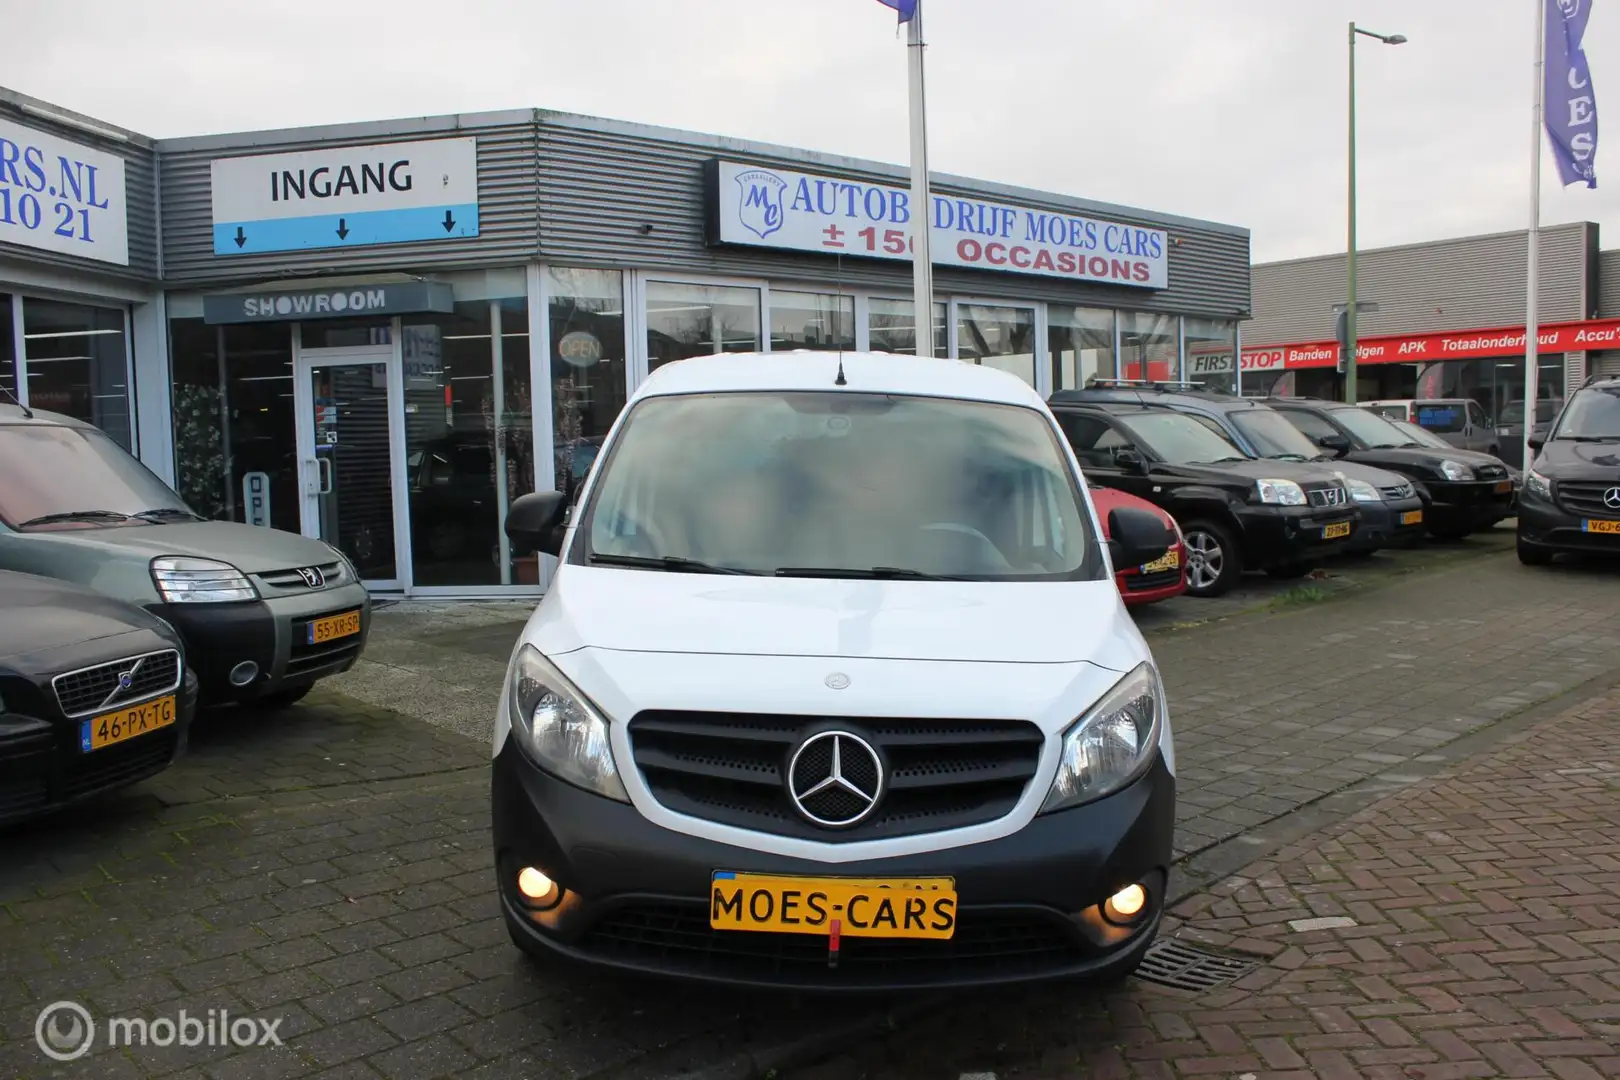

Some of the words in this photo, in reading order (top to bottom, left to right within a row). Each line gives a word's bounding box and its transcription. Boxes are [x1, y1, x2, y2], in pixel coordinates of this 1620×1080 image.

[271, 160, 413, 202] INGANG
[54, 202, 95, 243] 21
[790, 176, 1017, 238] AUTOBDRIJF
[1024, 211, 1097, 250] MOES
[1103, 225, 1162, 260] CARS
[858, 226, 914, 254] 15
[956, 238, 1151, 282] OCCASIONS
[243, 289, 386, 317] SHOWROOM
[559, 339, 600, 358] OPEN
[1240, 351, 1282, 369] STOP
[1289, 346, 1332, 362] Banden
[1354, 344, 1385, 359] lgen
[1398, 340, 1427, 354] APK
[1441, 332, 1559, 352] Totaalonderud
[317, 615, 358, 640] 55-XR-SP
[97, 701, 170, 742] 46-PX-TG
[712, 887, 955, 931] MOES-CARS
